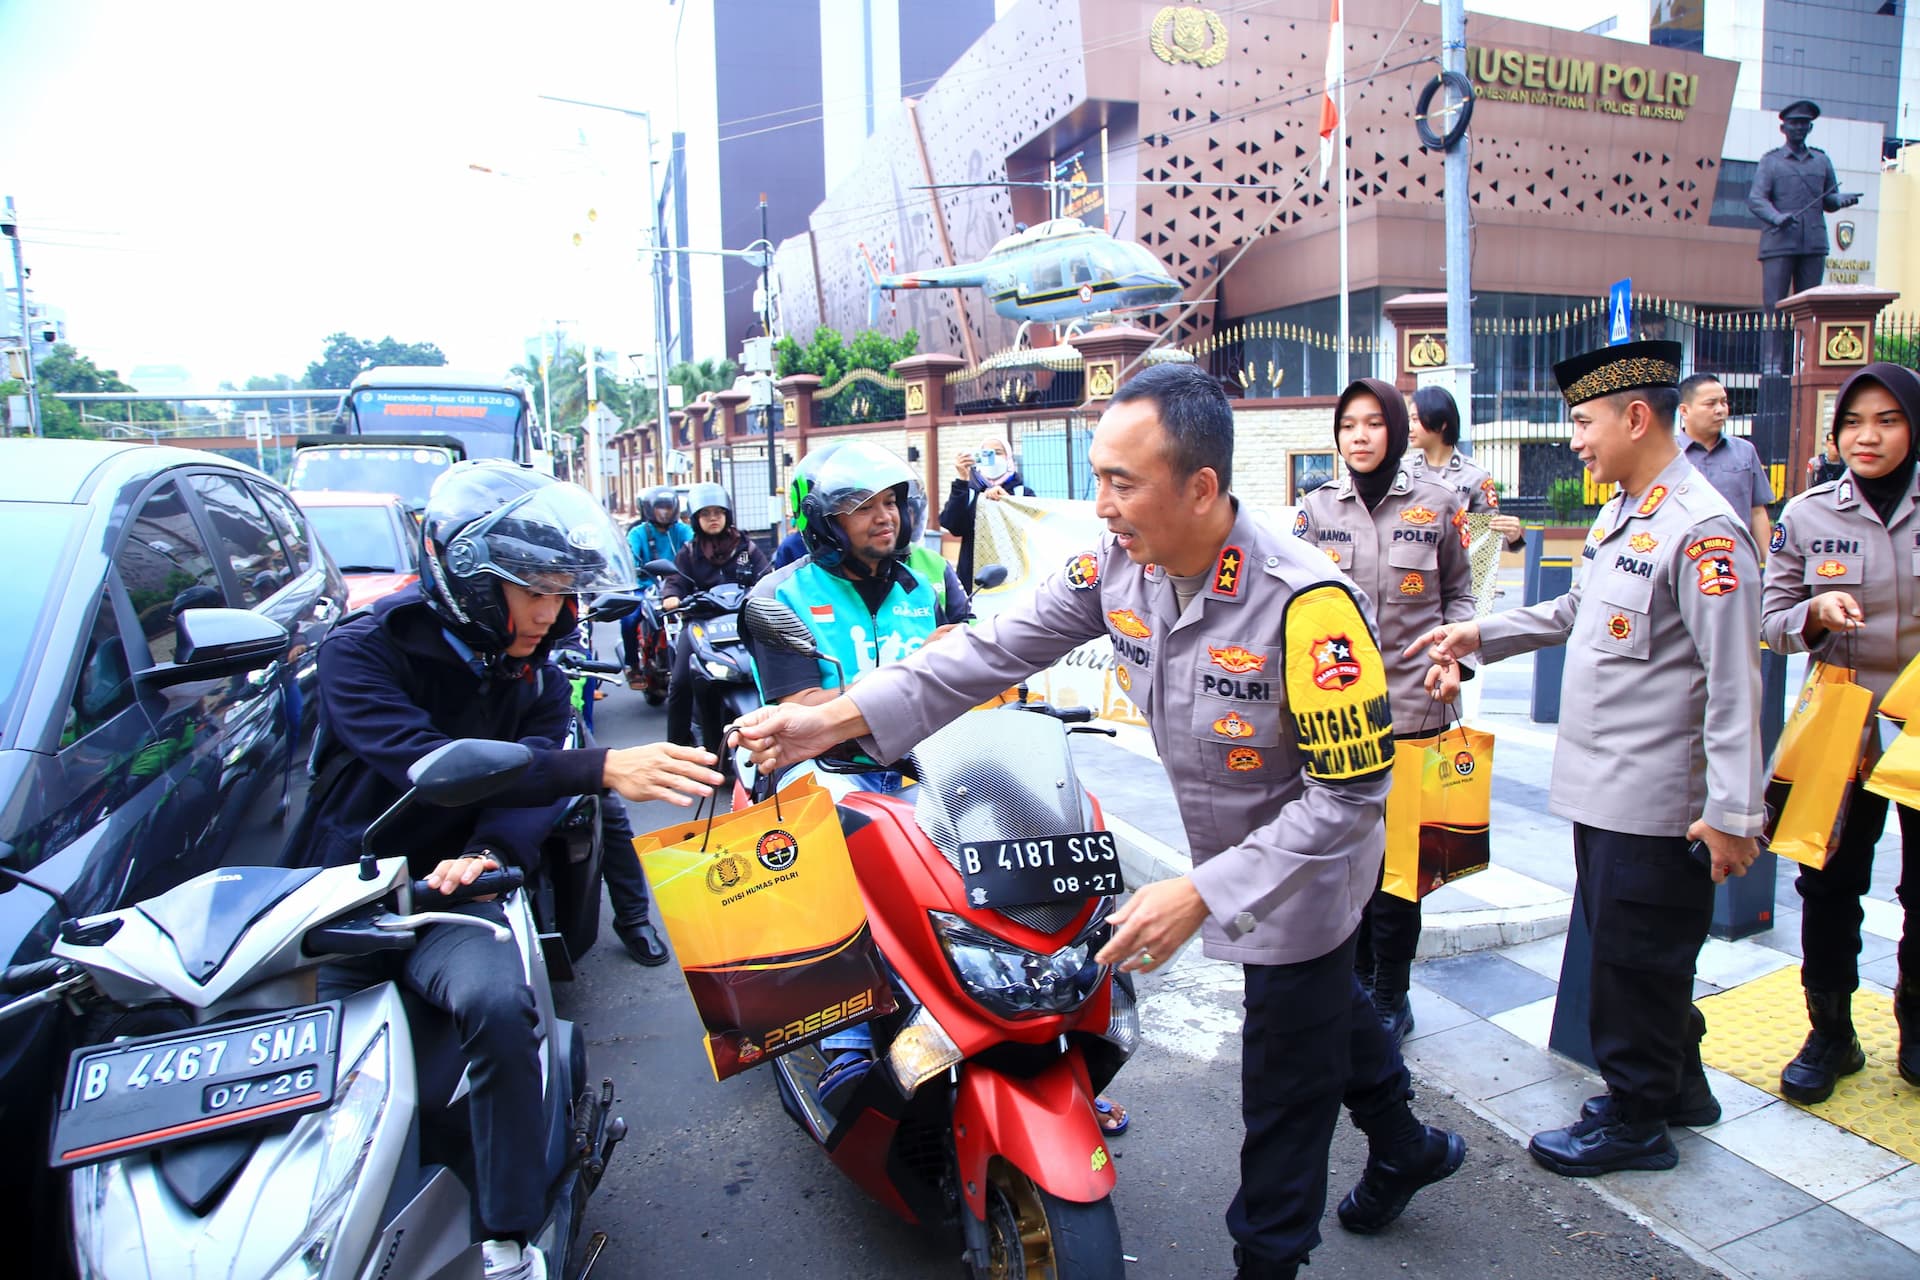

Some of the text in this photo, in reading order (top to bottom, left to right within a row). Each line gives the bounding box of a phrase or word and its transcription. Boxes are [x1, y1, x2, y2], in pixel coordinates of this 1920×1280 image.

[1601, 62, 1699, 108] POLRI
[1474, 85, 1687, 122] ONESIAN NATIONAL POLICE MUSEUM
[377, 393, 502, 406] Mercedes-Benz OH 1526
[1393, 529, 1438, 544] POLRI
[1688, 538, 1732, 557] DIV HUMAS
[1811, 539, 1859, 554] CENI
[1615, 555, 1654, 578] POLRI
[1203, 674, 1270, 701] POLRI
[1298, 704, 1362, 746] SATGAS
[963, 834, 1116, 875] B 4187 SCS
[721, 871, 799, 907] DIVISI HUMAS POLRI
[763, 987, 874, 1050] PRESISI
[83, 1020, 319, 1102] B 4467 SNA
